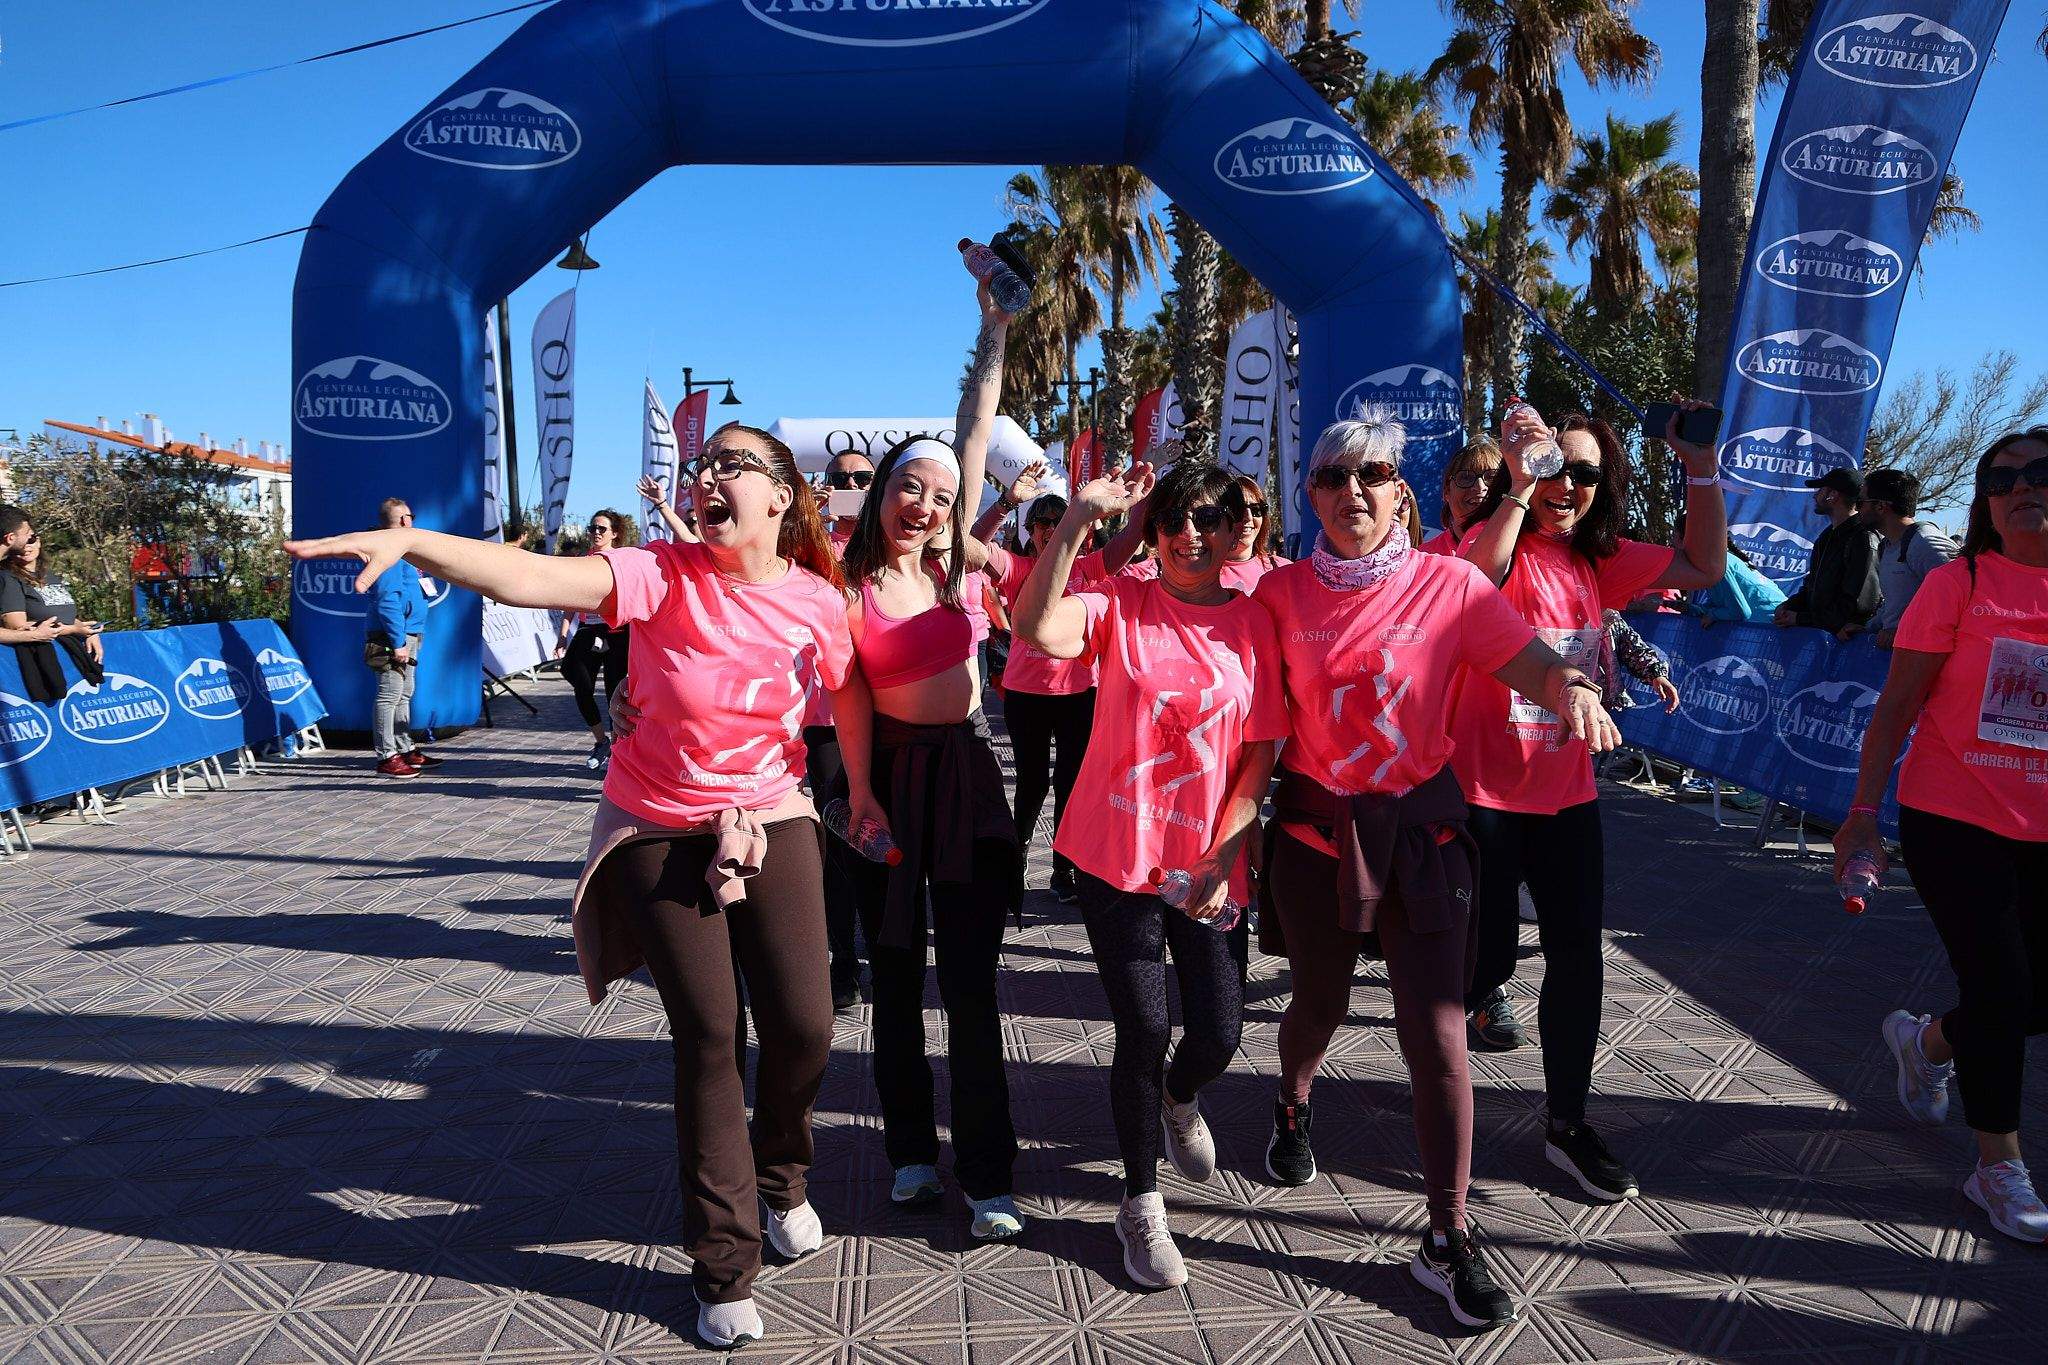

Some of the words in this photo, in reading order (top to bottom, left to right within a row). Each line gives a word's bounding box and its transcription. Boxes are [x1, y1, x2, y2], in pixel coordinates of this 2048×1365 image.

[1856, 34, 1907, 47] CENTRAL
[1911, 41, 1963, 54] LECHERA
[1823, 35, 1961, 76] ASTURIANA
[442, 111, 497, 123] CENTRAL
[502, 113, 562, 127] LECHERA
[413, 120, 568, 153] ASTURIANA
[1253, 143, 1307, 153] CENTRAL
[1820, 145, 1869, 157] CENTRAL
[1227, 148, 1368, 178] ASTURIANA
[1790, 143, 1923, 179] ASTURIANA
[1766, 249, 1890, 285] ASTURIANA
[1745, 348, 1871, 385] ASTURIANA
[316, 384, 370, 393] CENTRAL
[300, 387, 440, 424] ASTURIANA
[1726, 444, 1842, 479] ASTURIAN
[315, 561, 361, 570] CENTRA
[1291, 630, 1338, 643] OYSHO
[70, 698, 165, 732] ASTURIANA
[1996, 717, 2026, 728] CARRERA
[1994, 727, 2035, 742] OYSHO
[1963, 751, 2021, 770] CARRERA
[2025, 757, 2040, 771] DE
[2025, 772, 2048, 784] 2025
